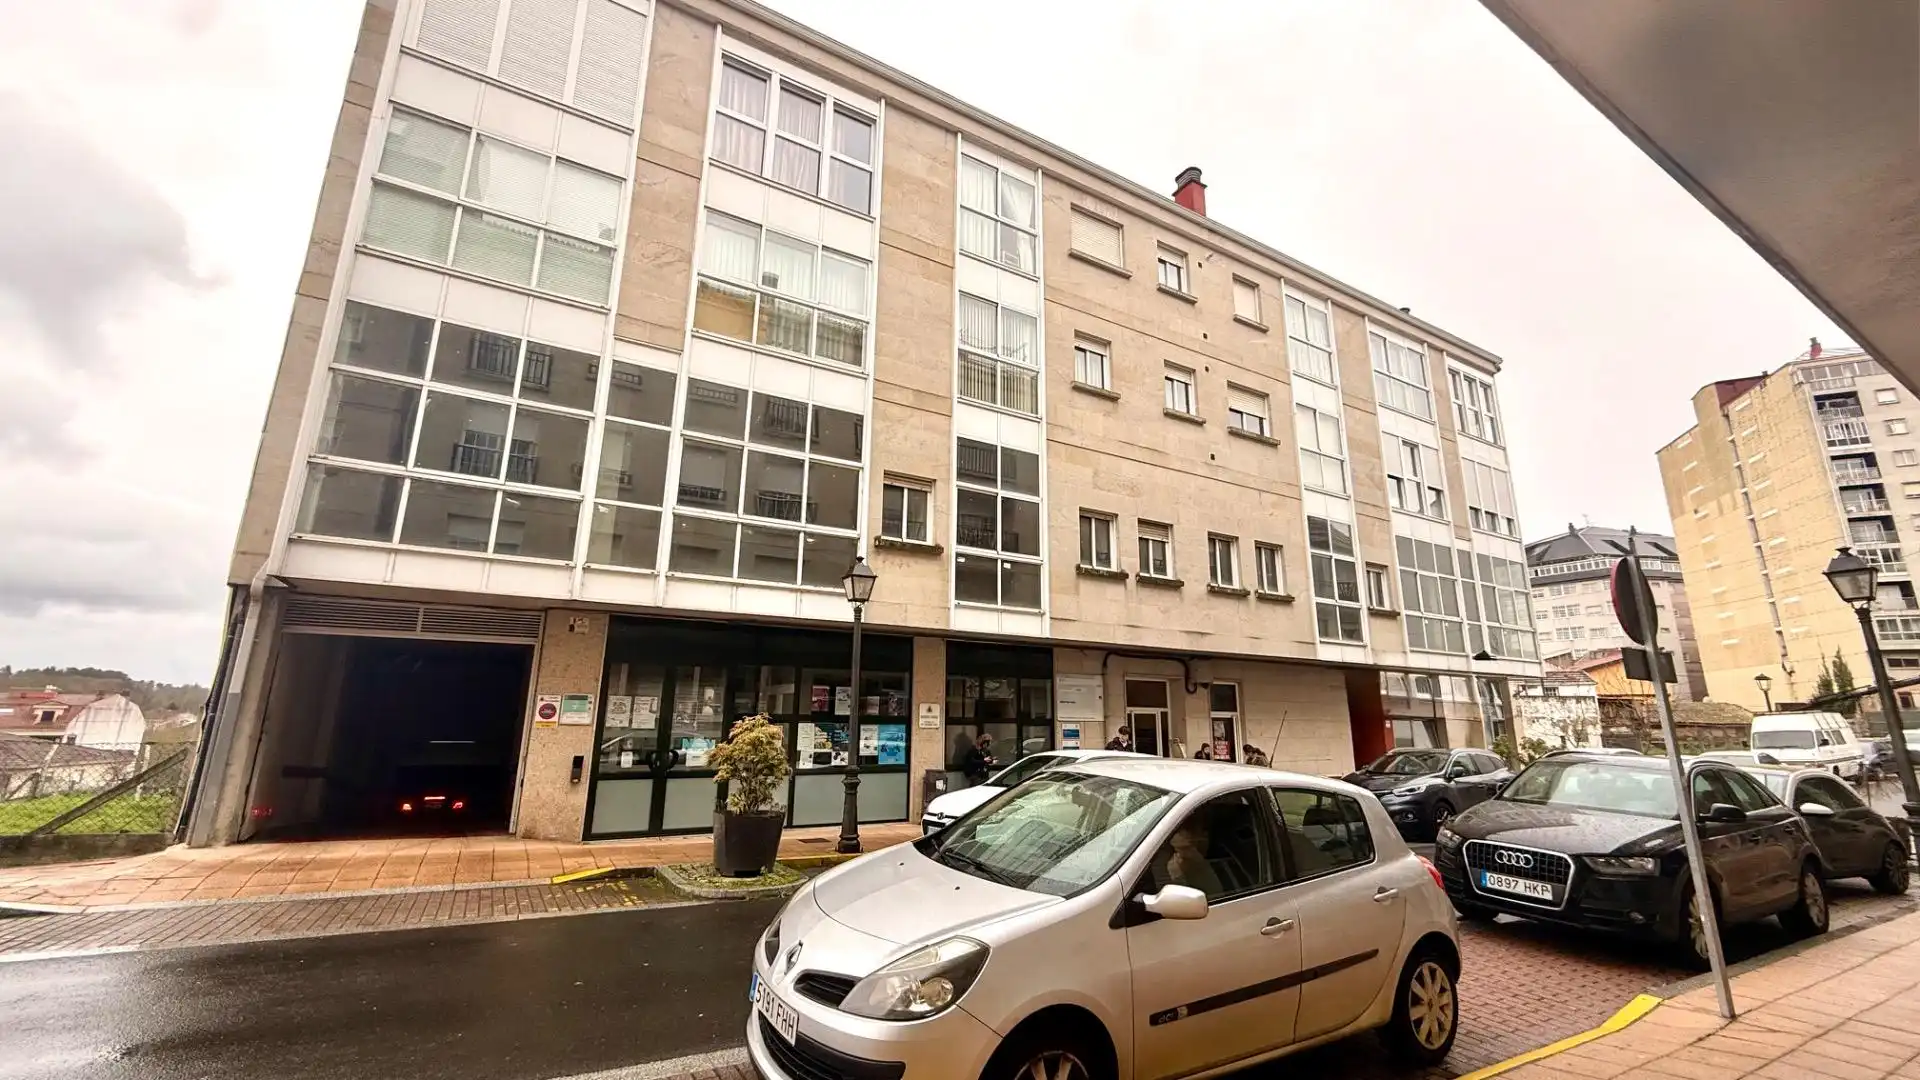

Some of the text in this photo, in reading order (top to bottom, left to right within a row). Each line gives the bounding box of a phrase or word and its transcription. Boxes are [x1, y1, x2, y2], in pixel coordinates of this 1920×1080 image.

[1488, 875, 1549, 895] 0897 HKP
[756, 982, 795, 1038] 5191 FHH
